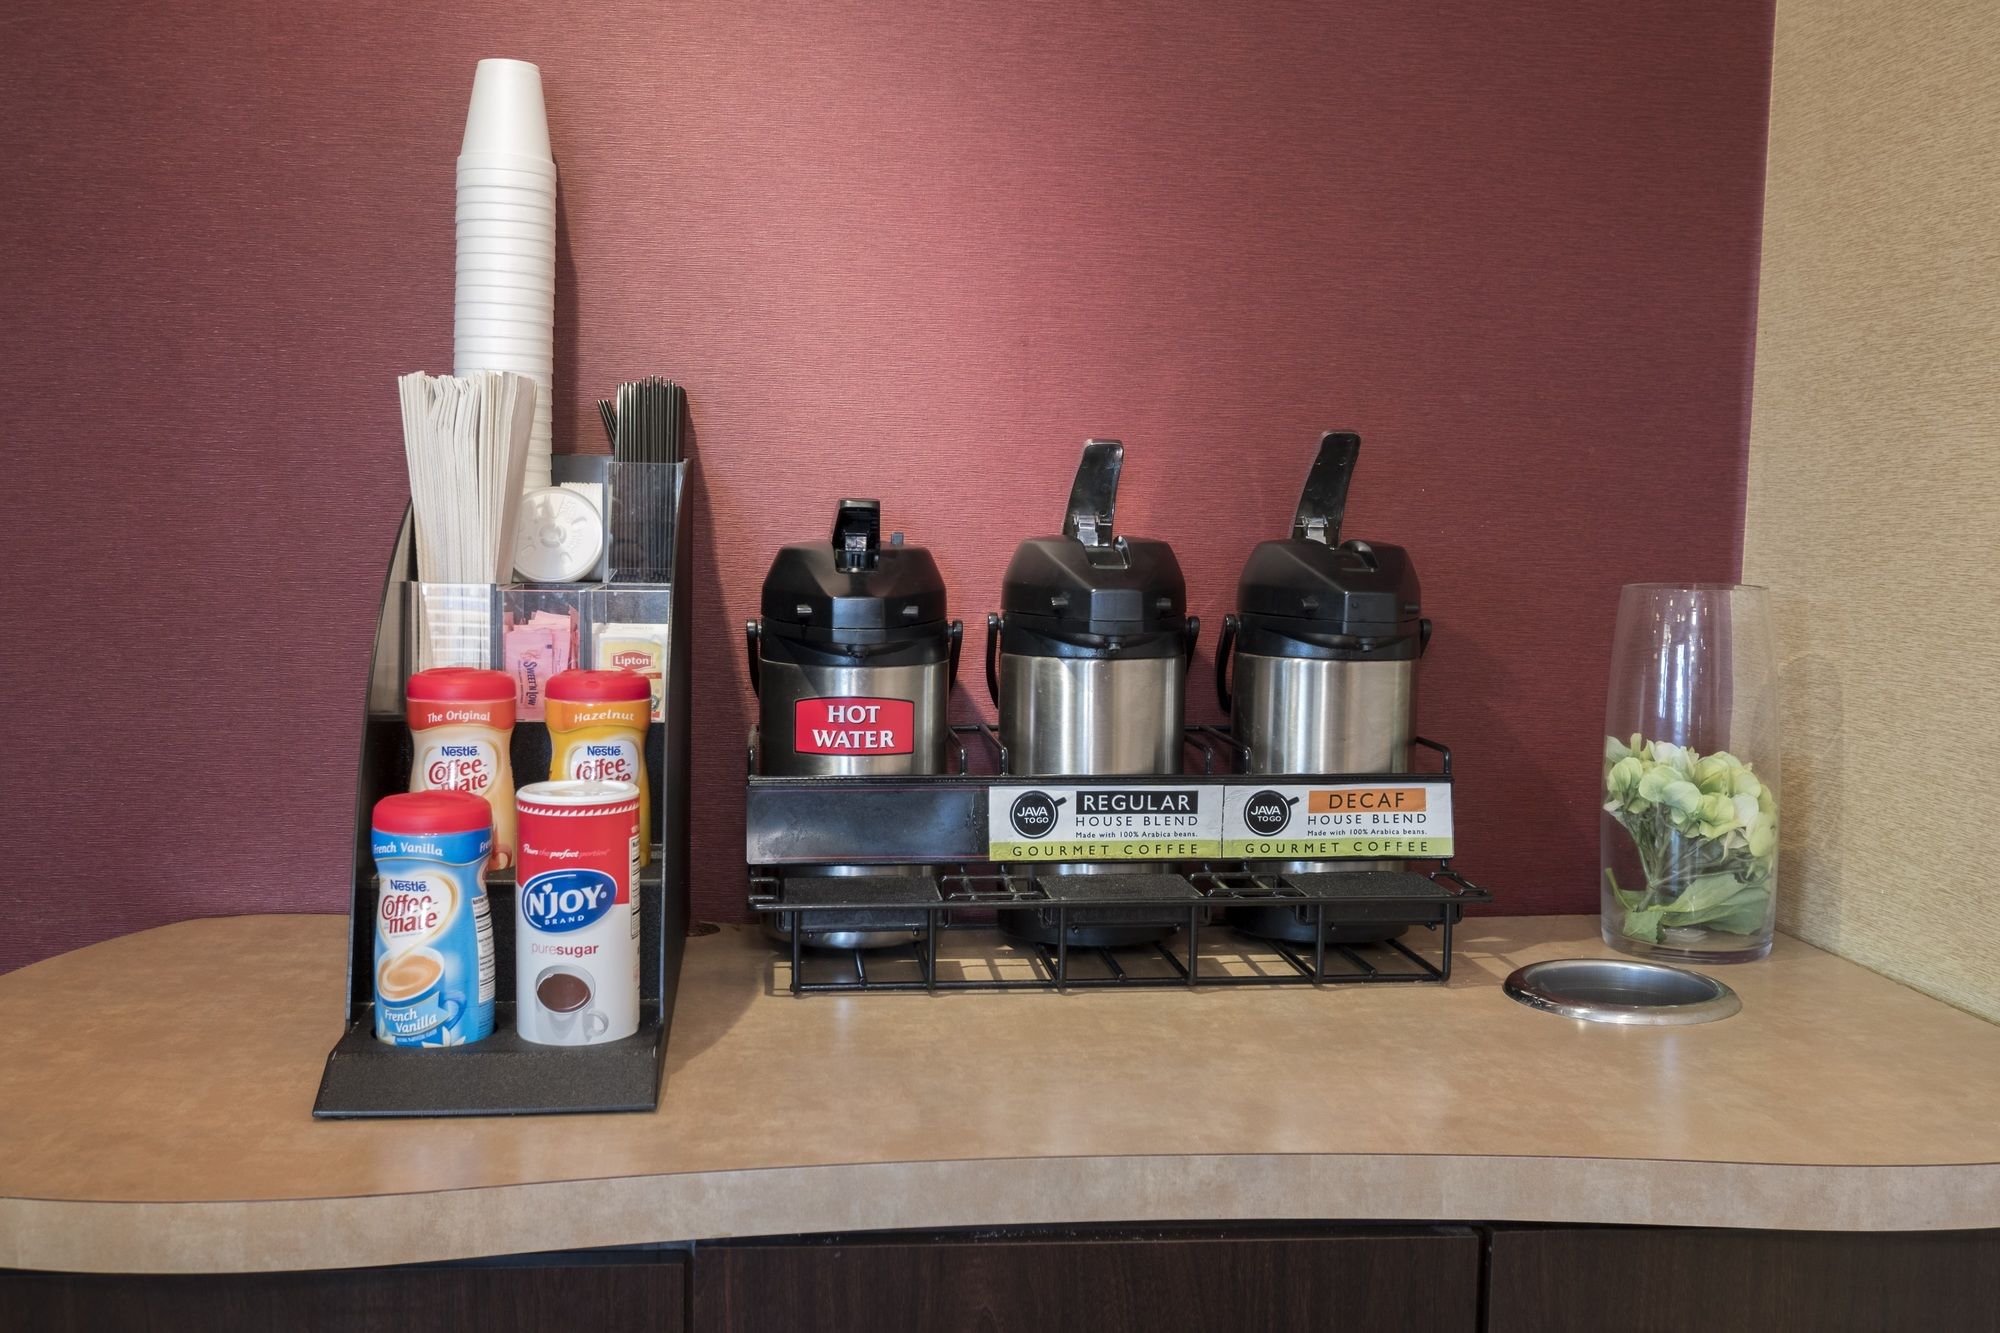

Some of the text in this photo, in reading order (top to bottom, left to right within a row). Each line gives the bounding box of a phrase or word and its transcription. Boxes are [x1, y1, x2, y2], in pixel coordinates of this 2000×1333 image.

[615, 656, 649, 666] Lipton
[427, 710, 490, 723] The Original
[574, 709, 634, 723] Hazelnut
[828, 705, 880, 723] HOT
[812, 729, 894, 748] WATER
[1083, 795, 1190, 811] REGULAR
[1329, 792, 1405, 809] DECAF
[1017, 806, 1048, 817] JAVA
[1250, 805, 1280, 816] JAVA
[1075, 816, 1198, 827] HOUSE BLEND
[1308, 814, 1427, 825] HOUSE BLEND
[400, 842, 443, 856] Vanilla
[549, 849, 580, 859] perfect
[1012, 843, 1198, 856] GOURMET COFFEE
[1245, 841, 1428, 854] GOURMET COFFEE
[545, 915, 585, 925] BRAND
[385, 1008, 417, 1022] French
[396, 1014, 437, 1032] Vanilla
